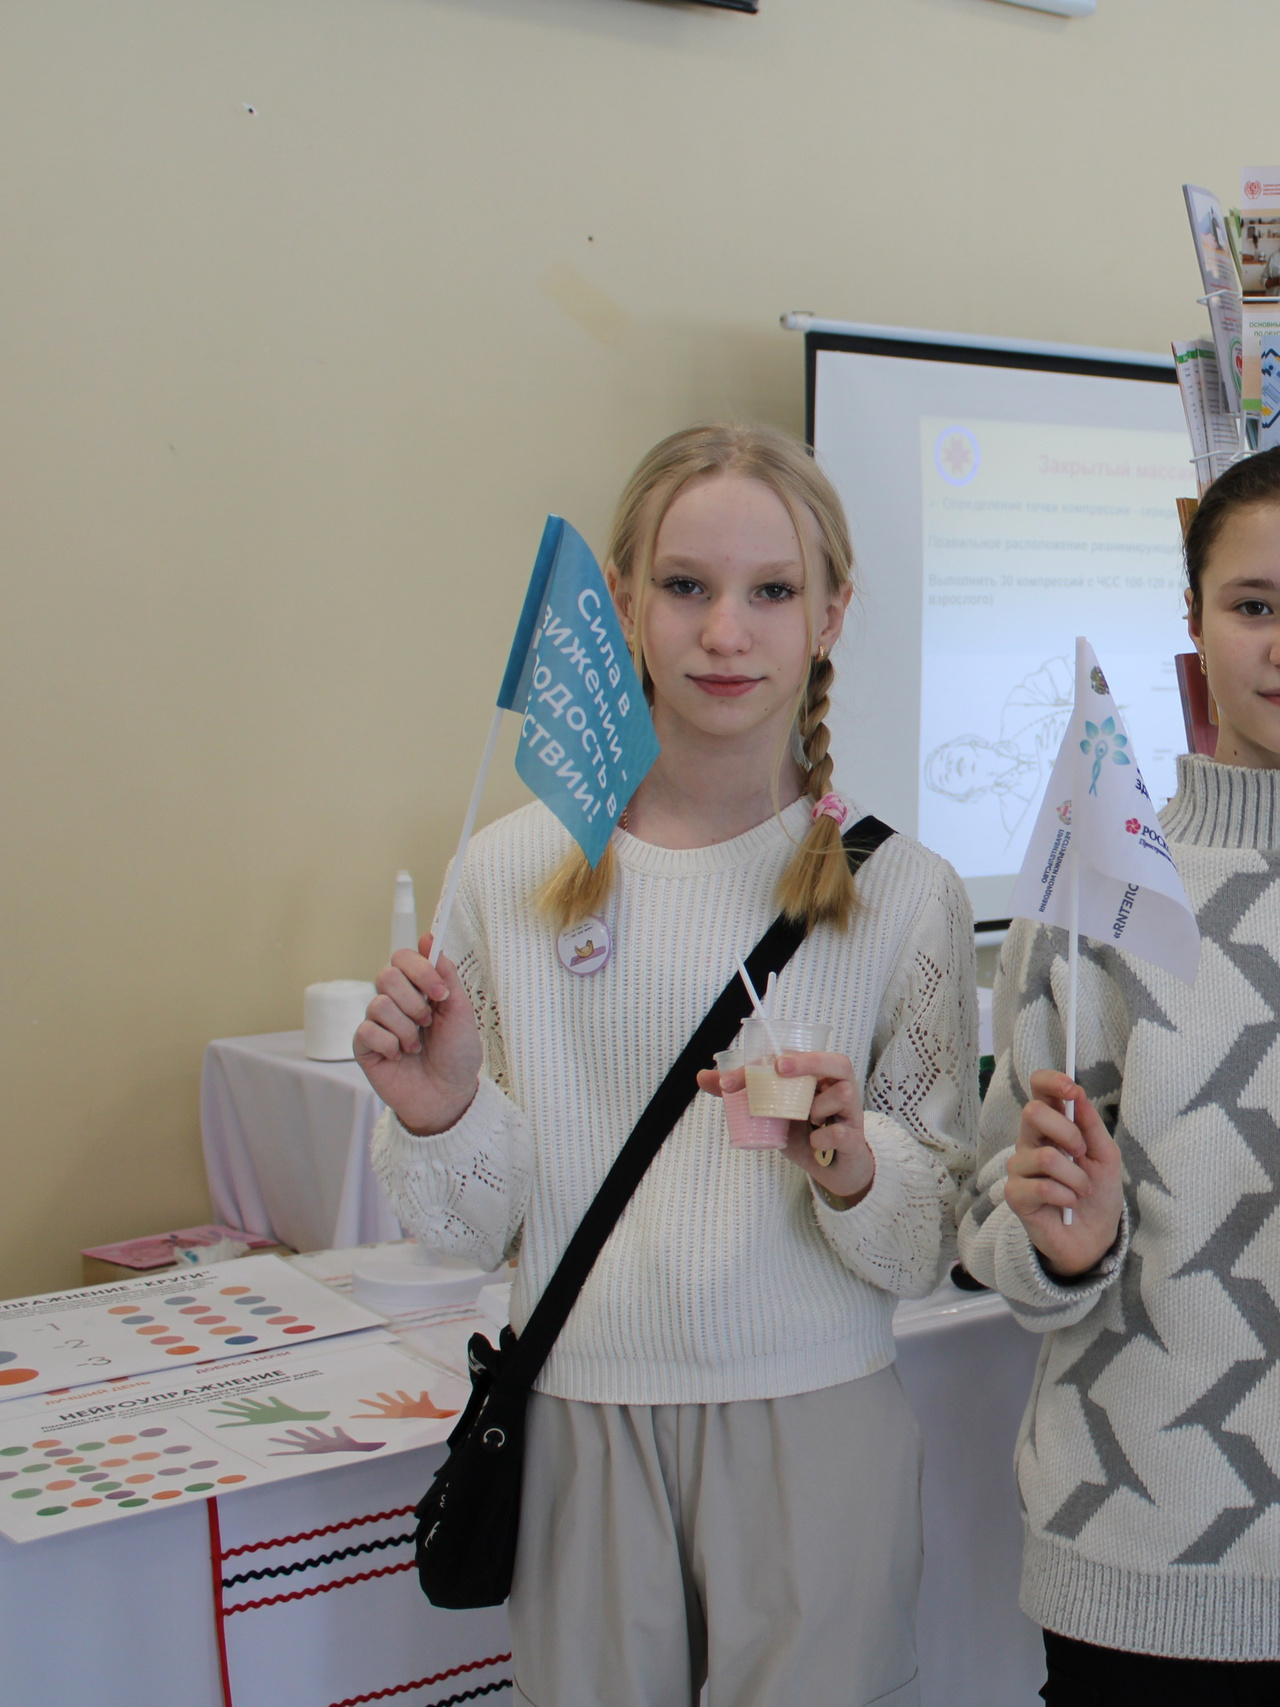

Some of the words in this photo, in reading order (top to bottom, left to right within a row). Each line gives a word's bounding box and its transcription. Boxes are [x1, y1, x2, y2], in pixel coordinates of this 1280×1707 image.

[1038, 454, 1131, 480] Закрытый
[1000, 575, 1014, 587] 30
[578, 588, 621, 689] Сила
[618, 696, 631, 718] в
[543, 604, 622, 764] вижении
[606, 791, 618, 819] в
[0, 1285, 130, 1310] ПРАЖНЕНИЕ
[112, 1381, 151, 1392] ДЕНЬ
[196, 1359, 252, 1374] ДОБРОЙ
[253, 1351, 292, 1362] НОЧИ
[59, 1369, 287, 1421] НЕЙРОУПРАЖНЕНИЕ
